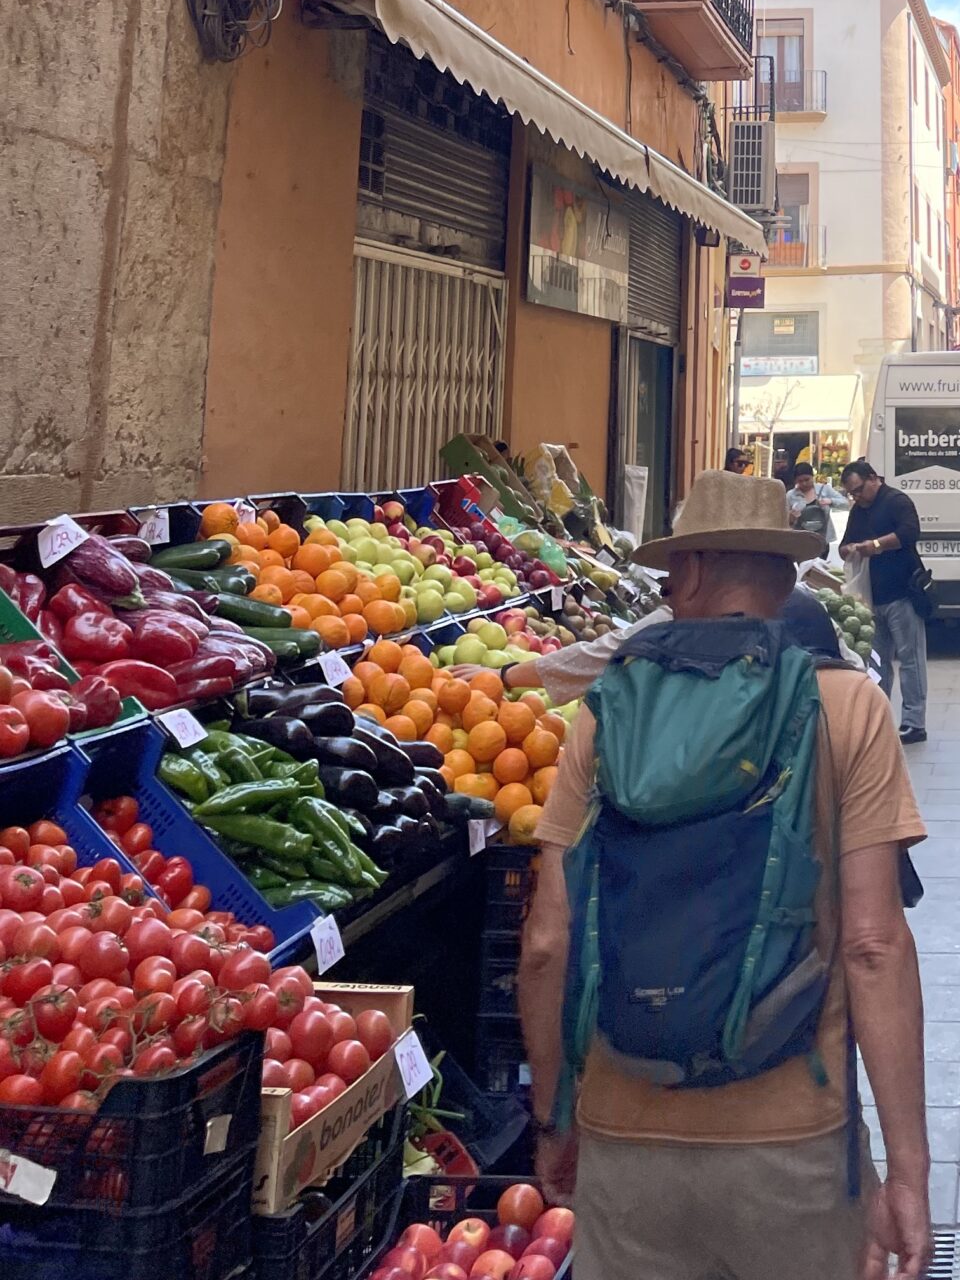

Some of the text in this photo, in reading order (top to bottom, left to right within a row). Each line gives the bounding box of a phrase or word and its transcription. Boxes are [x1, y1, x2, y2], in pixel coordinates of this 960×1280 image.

[900, 479, 922, 490] 977
[925, 479, 945, 489] 588
[919, 541, 939, 553] 190
